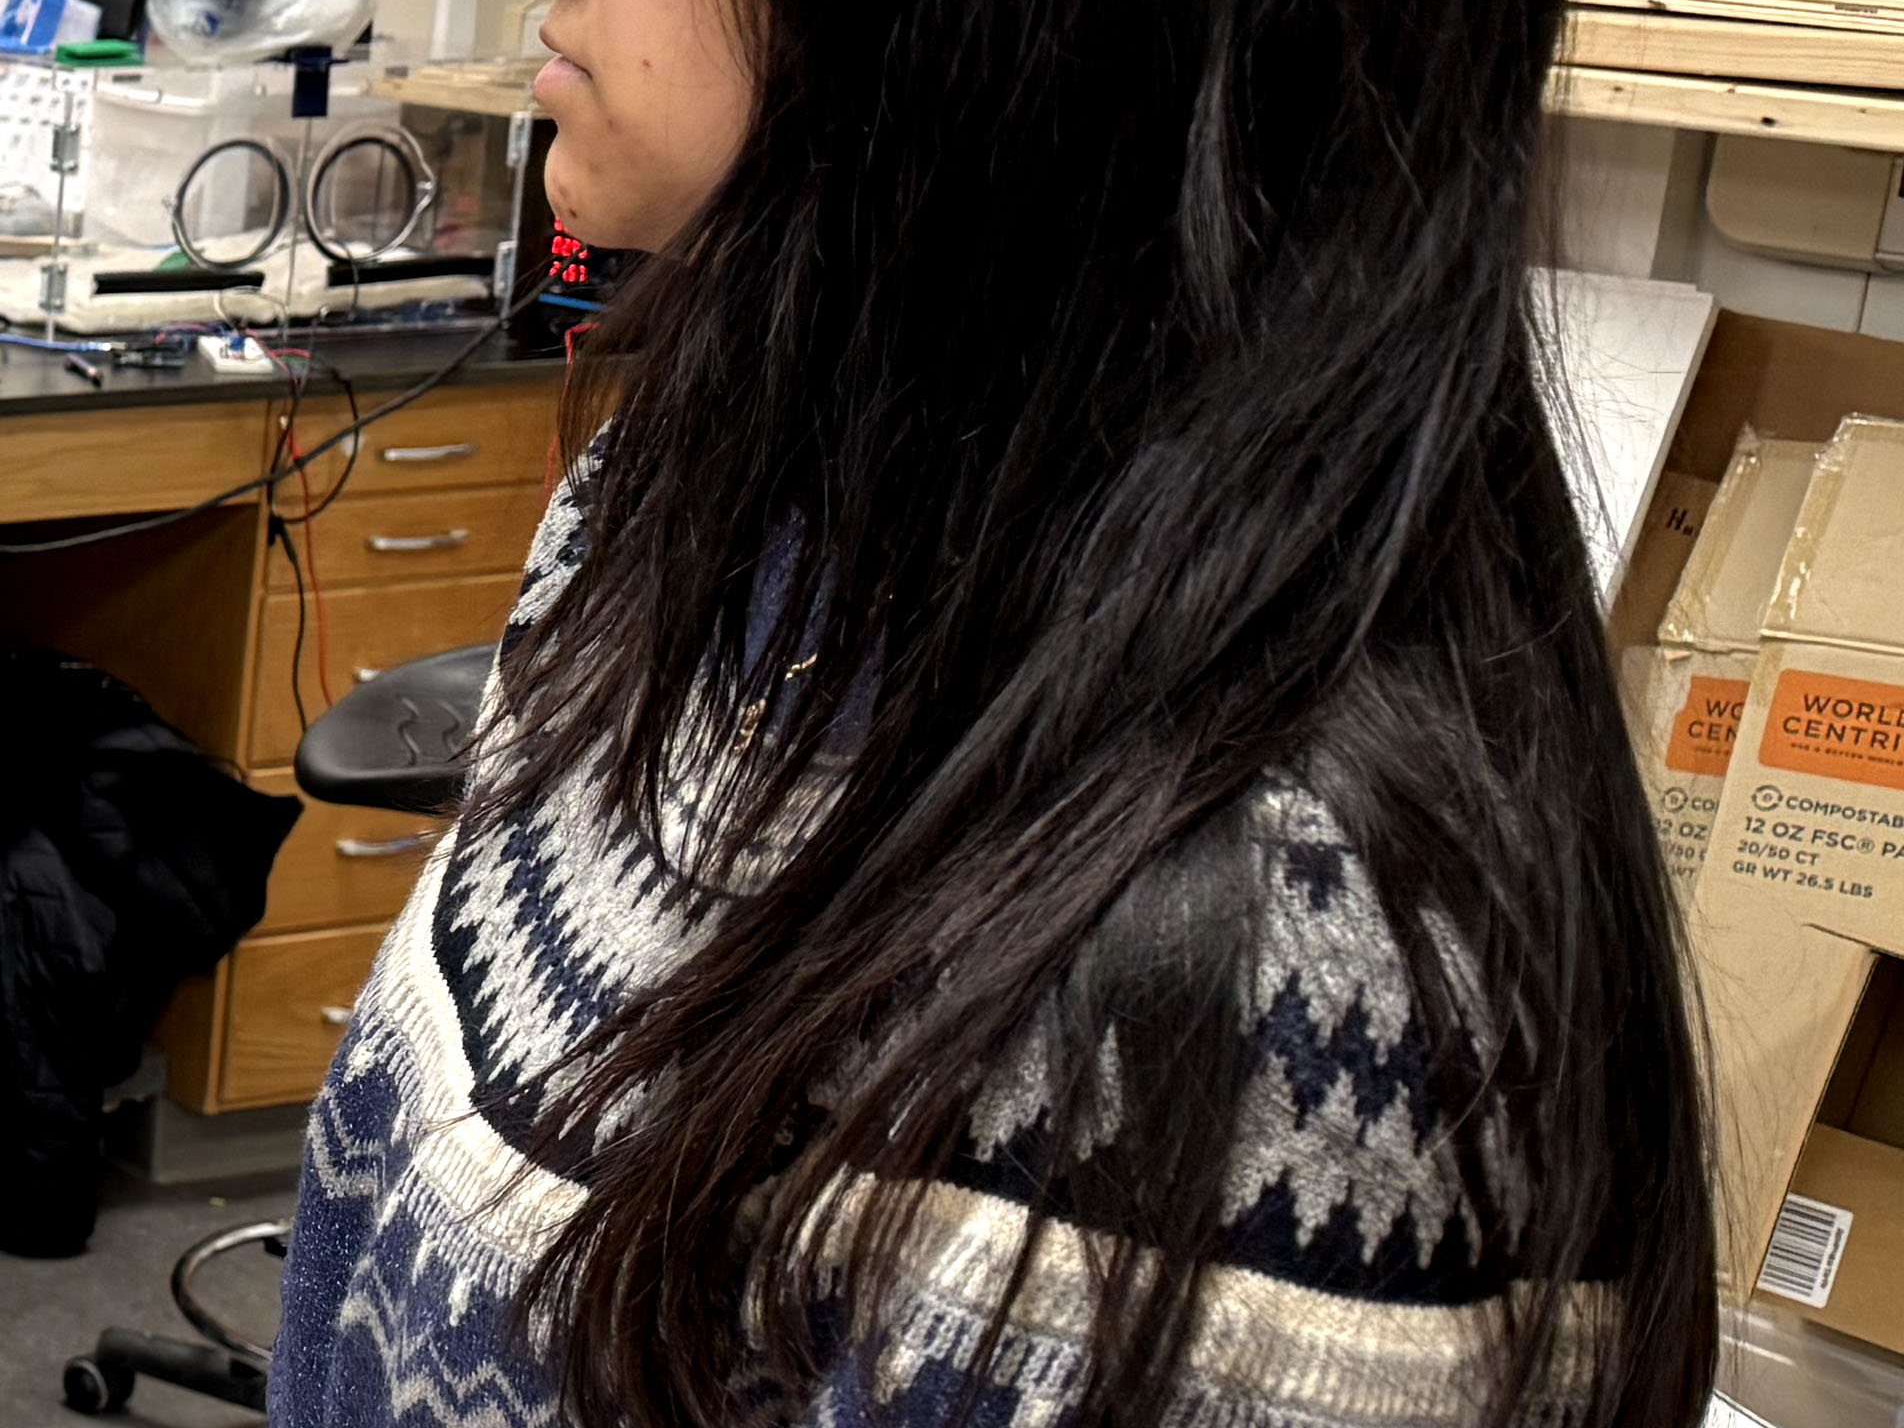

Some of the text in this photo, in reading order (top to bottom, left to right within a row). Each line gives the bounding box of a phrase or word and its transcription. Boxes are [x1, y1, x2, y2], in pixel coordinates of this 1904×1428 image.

[1785, 795, 1904, 830] COMPOSTAB
[1737, 839, 1821, 868] 20/50 CT
[1743, 816, 1765, 836] 12
[1772, 821, 1806, 843] OZ
[1881, 841, 1904, 861] PA
[1732, 860, 1874, 900] GR WT 26.5 LBS
